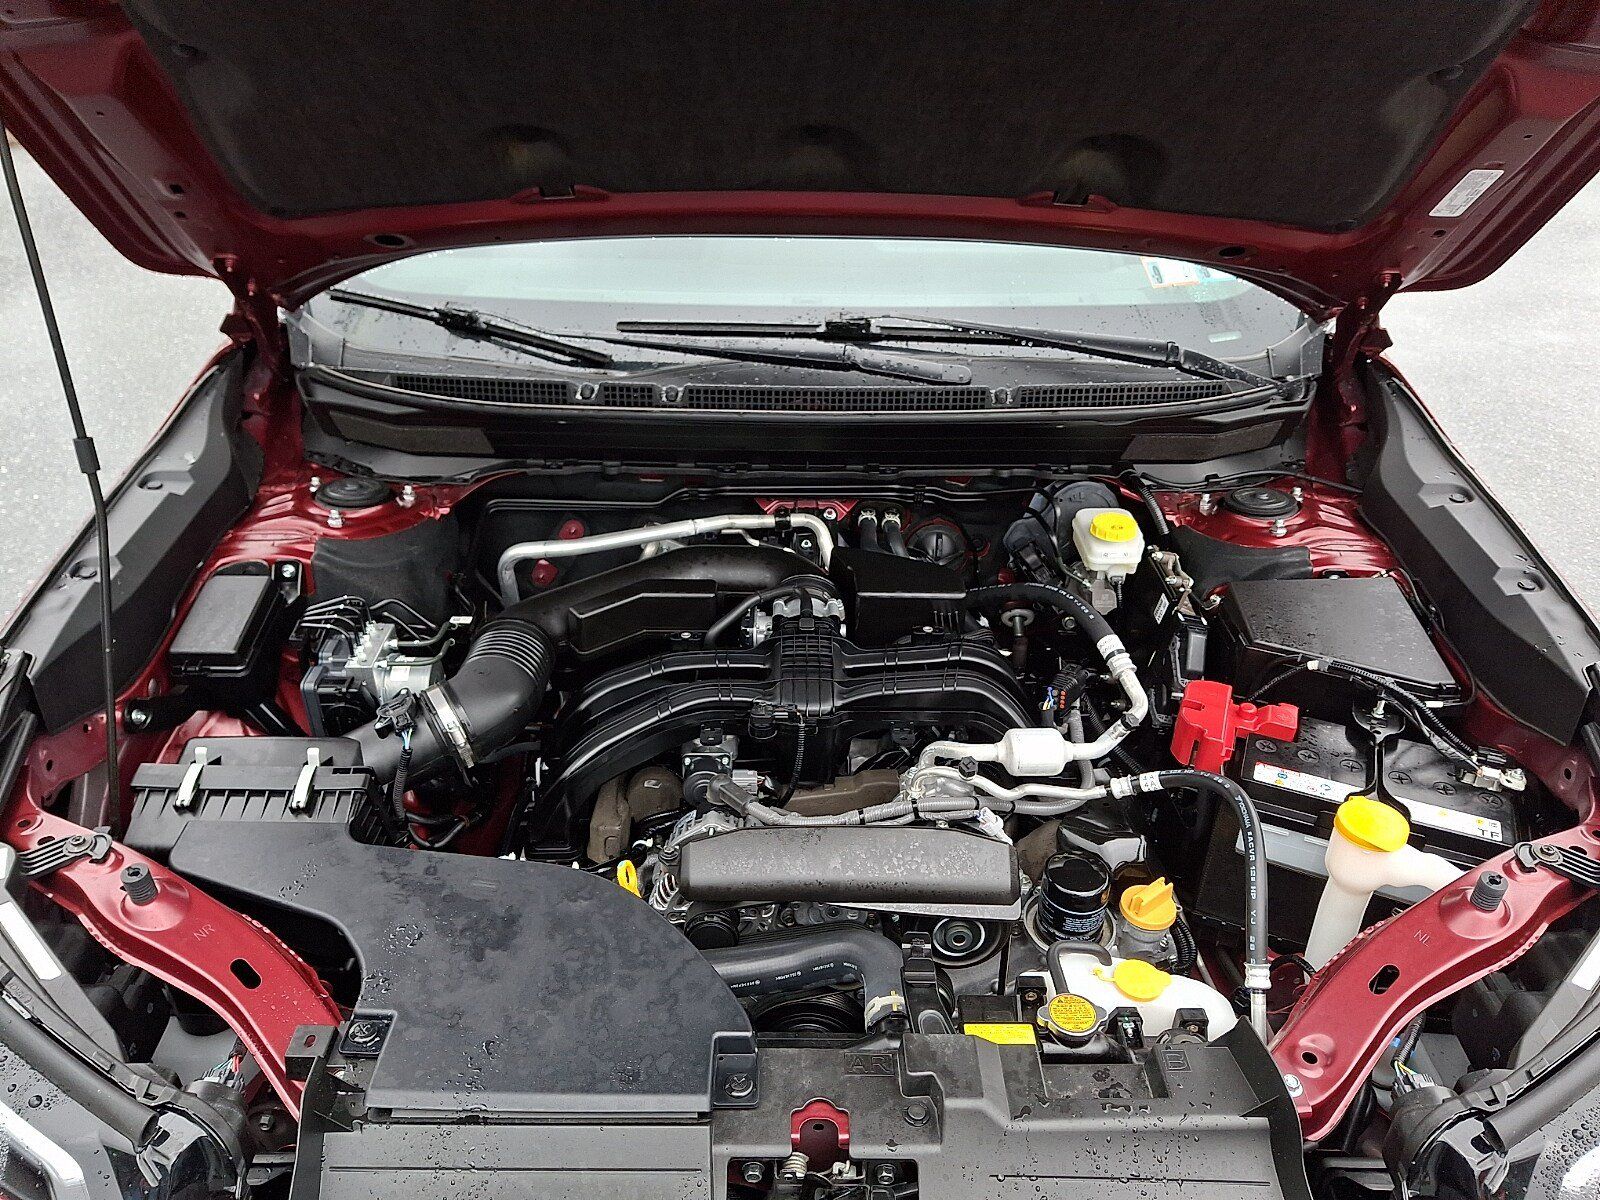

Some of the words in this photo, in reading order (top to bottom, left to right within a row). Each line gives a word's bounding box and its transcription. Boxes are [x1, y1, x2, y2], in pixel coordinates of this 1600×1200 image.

[193, 924, 215, 941] NR
[1413, 929, 1430, 947] NL
[848, 1056, 890, 1073] AR
